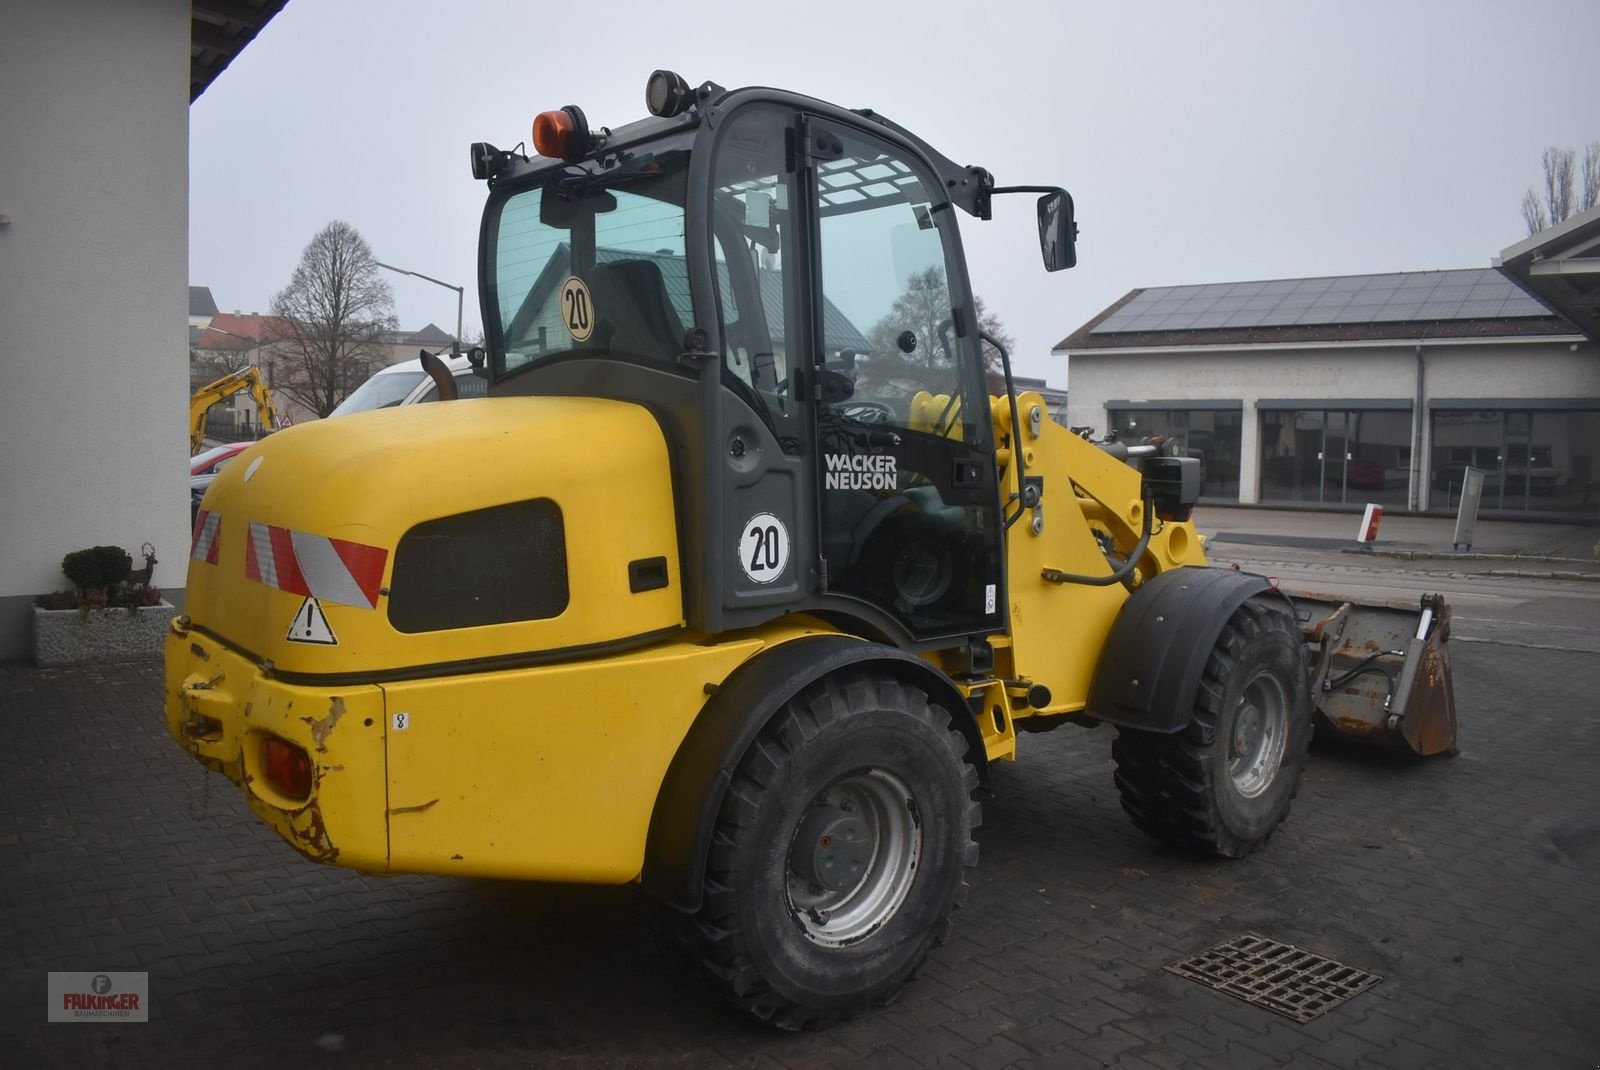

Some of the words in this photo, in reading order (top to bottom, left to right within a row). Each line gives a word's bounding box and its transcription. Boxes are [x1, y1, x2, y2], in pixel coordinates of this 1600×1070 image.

[566, 288, 588, 329] 20
[824, 453, 897, 472] WACKER
[825, 472, 897, 490] NEUSON
[750, 525, 779, 571] 20
